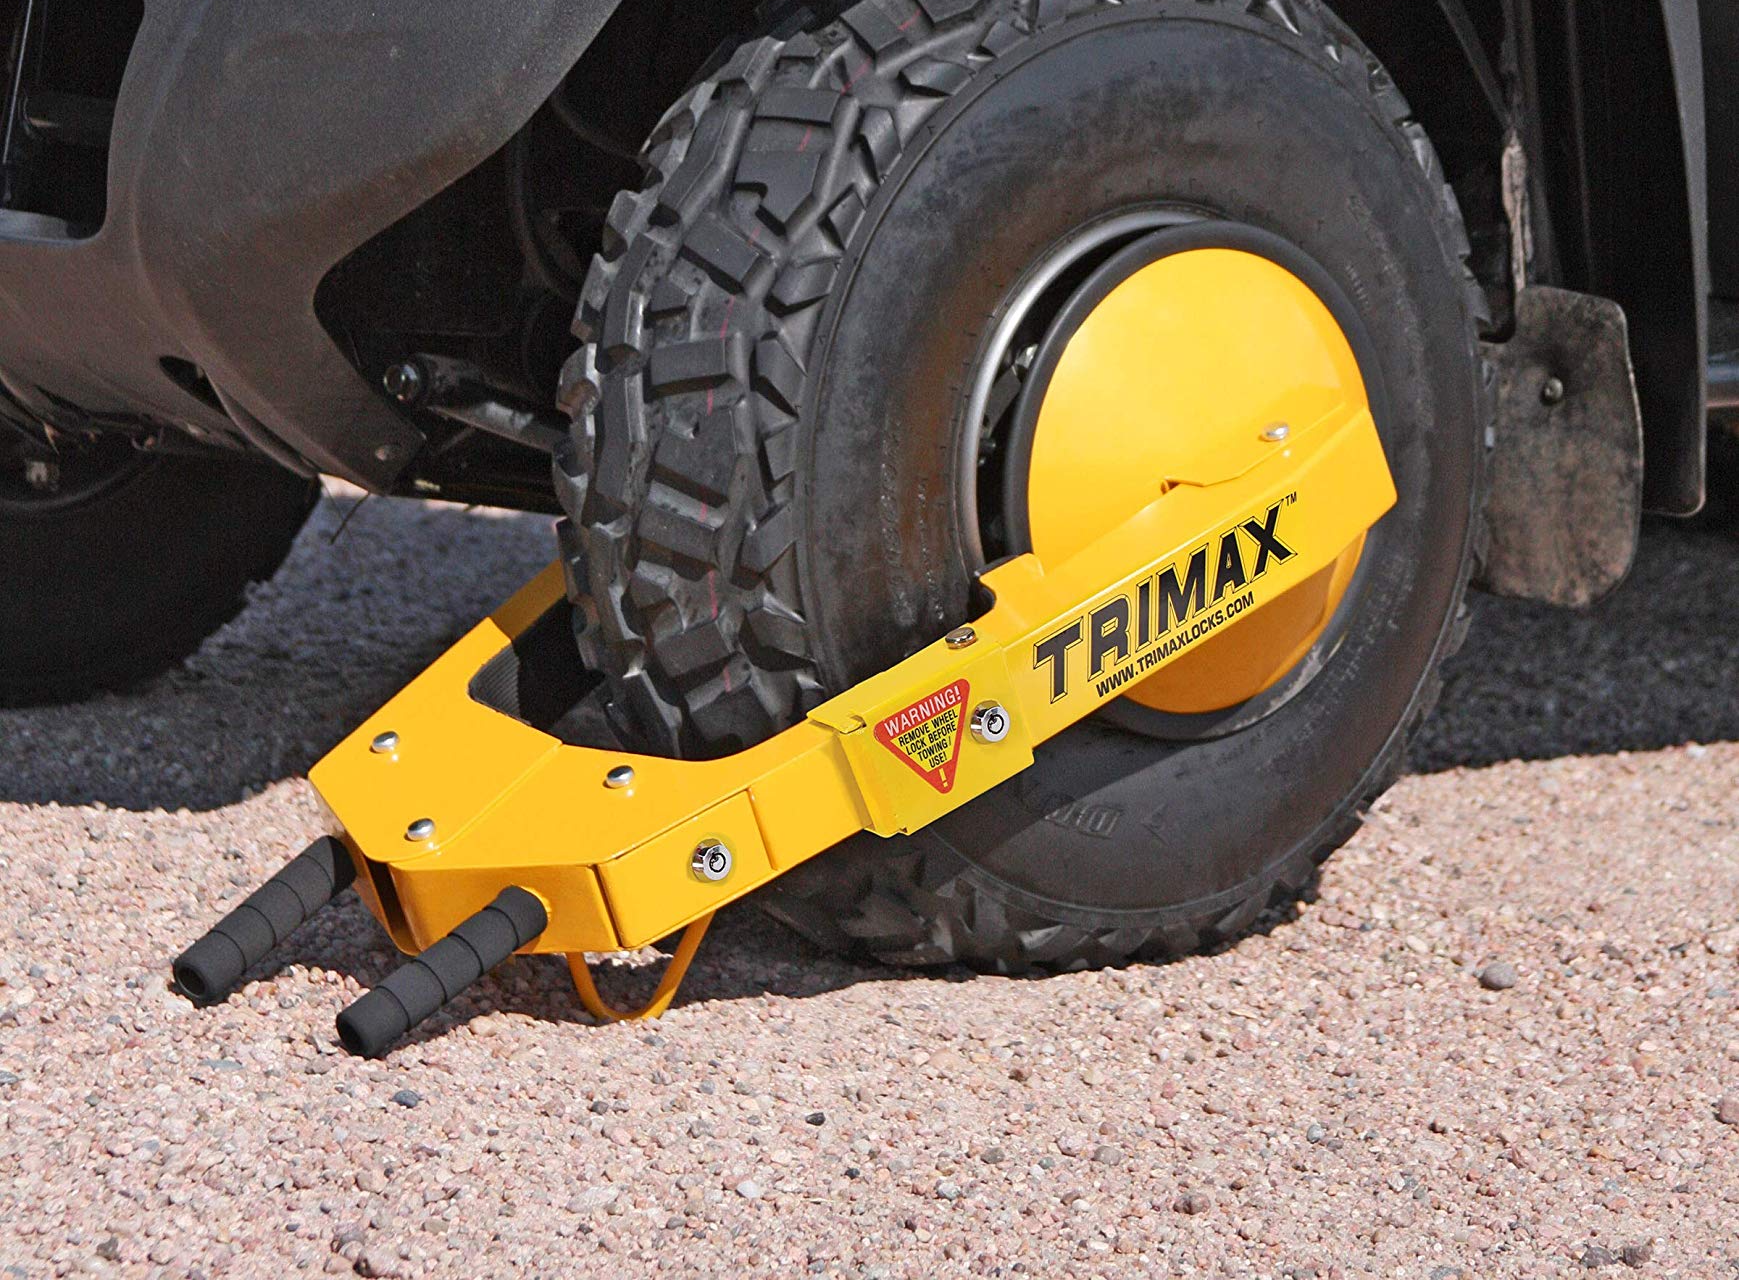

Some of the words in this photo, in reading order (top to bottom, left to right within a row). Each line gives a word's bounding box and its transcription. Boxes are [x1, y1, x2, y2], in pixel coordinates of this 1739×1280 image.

[1033, 498, 1298, 704] TRIMAX
[1096, 591, 1255, 697] WWW.TRIMAXLOCKS.COM
[884, 685, 962, 737] WARNING!
[898, 723, 930, 747] REMOVE
[931, 709, 958, 729] WHEEL
[905, 737, 927, 755] LOCK
[928, 721, 957, 744] BEFORE
[929, 751, 948, 768] USE!
